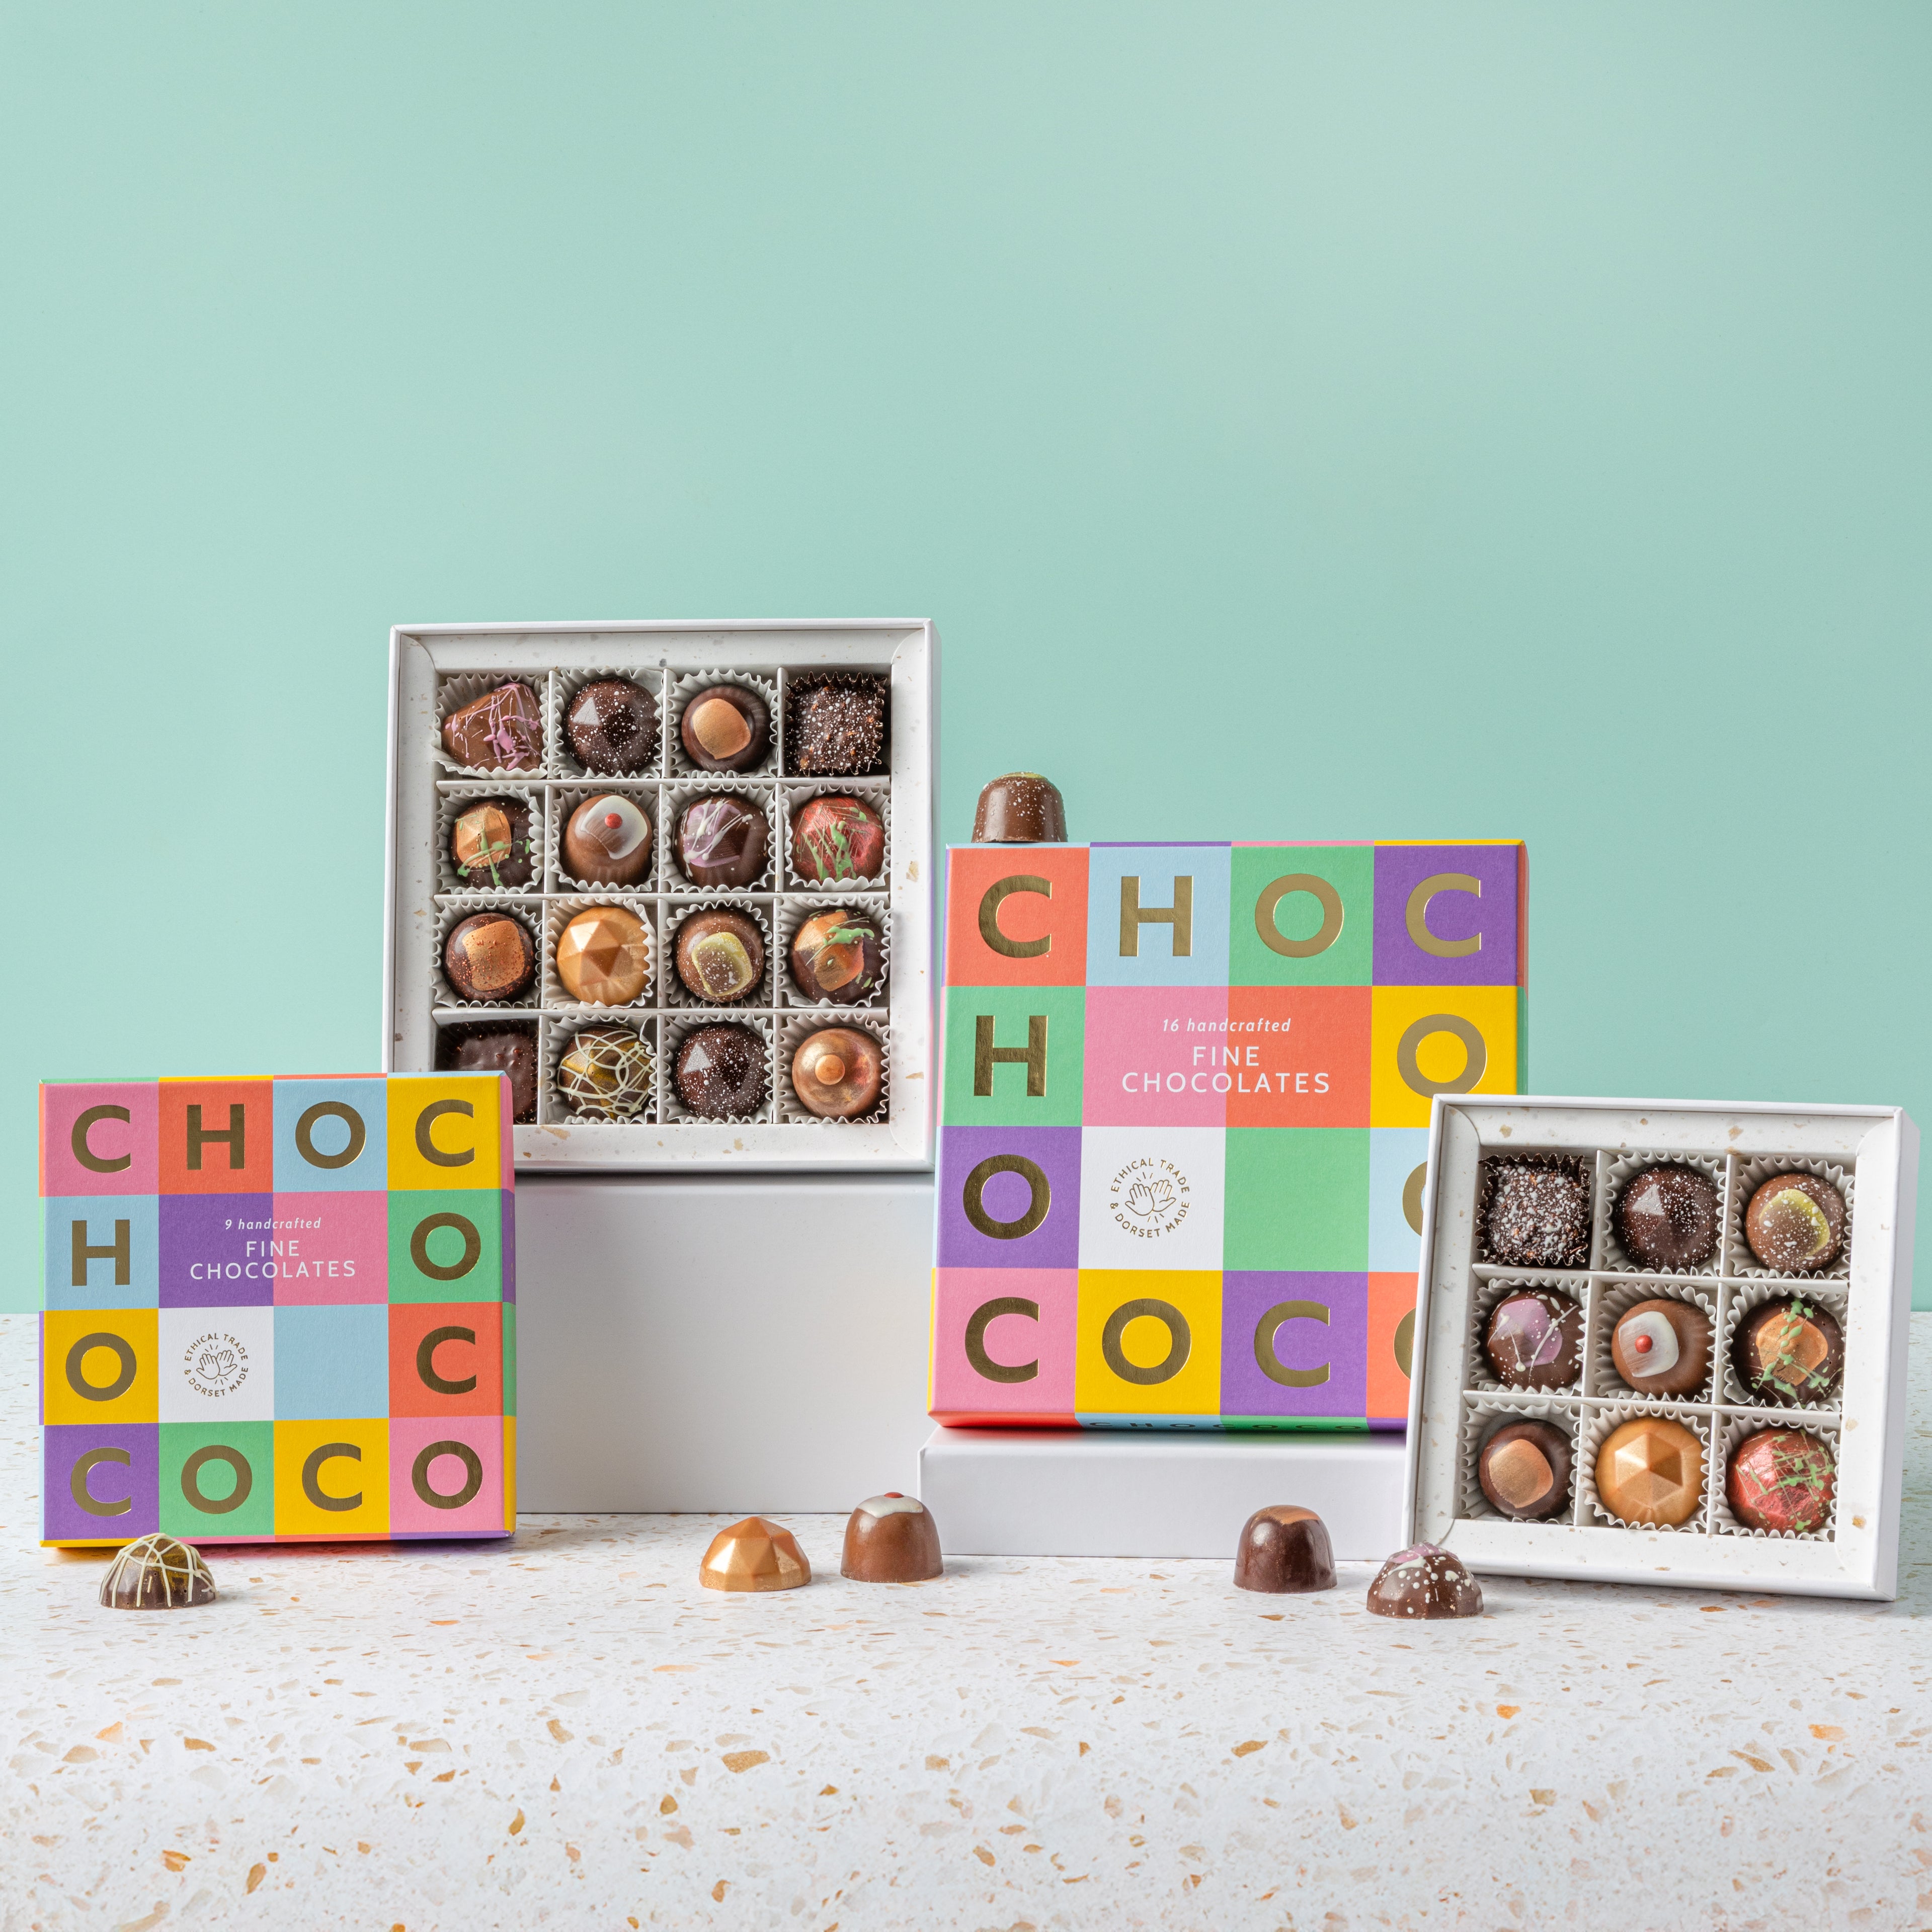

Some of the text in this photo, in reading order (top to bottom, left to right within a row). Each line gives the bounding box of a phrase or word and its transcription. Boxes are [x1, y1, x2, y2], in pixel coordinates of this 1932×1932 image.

[1162, 1017, 1291, 1032] 16 handcrafted
[1192, 1045, 1260, 1067] FINE
[1121, 1072, 1329, 1094] CHOCOLATES
[1110, 1157, 1190, 1193] ETHICAL TRADE
[225, 1217, 322, 1230] 9 handcrafted
[1115, 1213, 1160, 1238] DORSET
[1165, 1201, 1190, 1233] MADE
[246, 1240, 300, 1257] FINE
[190, 1259, 356, 1280] CHOCOLATES
[185, 1333, 248, 1361] ETHICAL TRADE
[189, 1378, 225, 1397] DORSET
[229, 1367, 249, 1392] MADE
